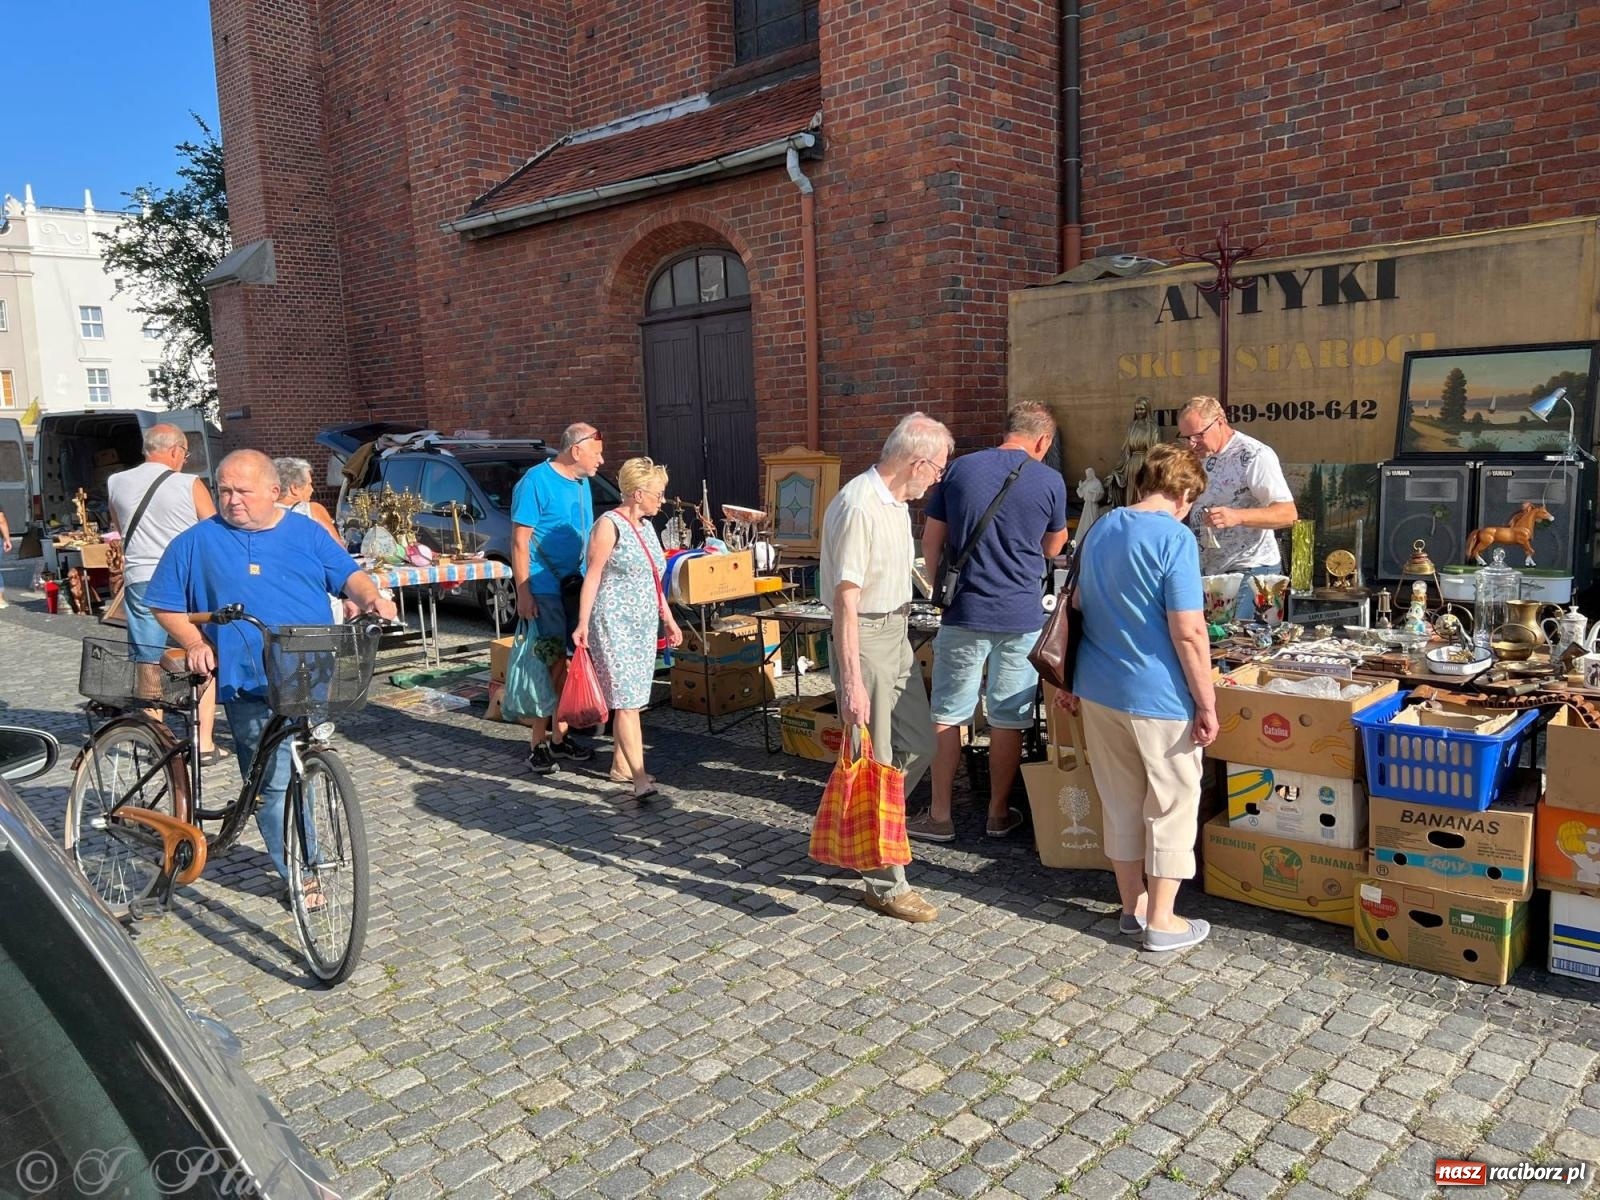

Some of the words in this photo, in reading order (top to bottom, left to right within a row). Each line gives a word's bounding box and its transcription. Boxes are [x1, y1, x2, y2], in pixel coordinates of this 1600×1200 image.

[1155, 256, 1400, 324] ANTYKI
[1118, 347, 1220, 380] SKUP
[1226, 399, 1378, 424] 89-908-642
[1400, 809, 1500, 835] BANANAS
[1209, 834, 1256, 851] PREMIUM
[1310, 854, 1361, 871] BANANAS
